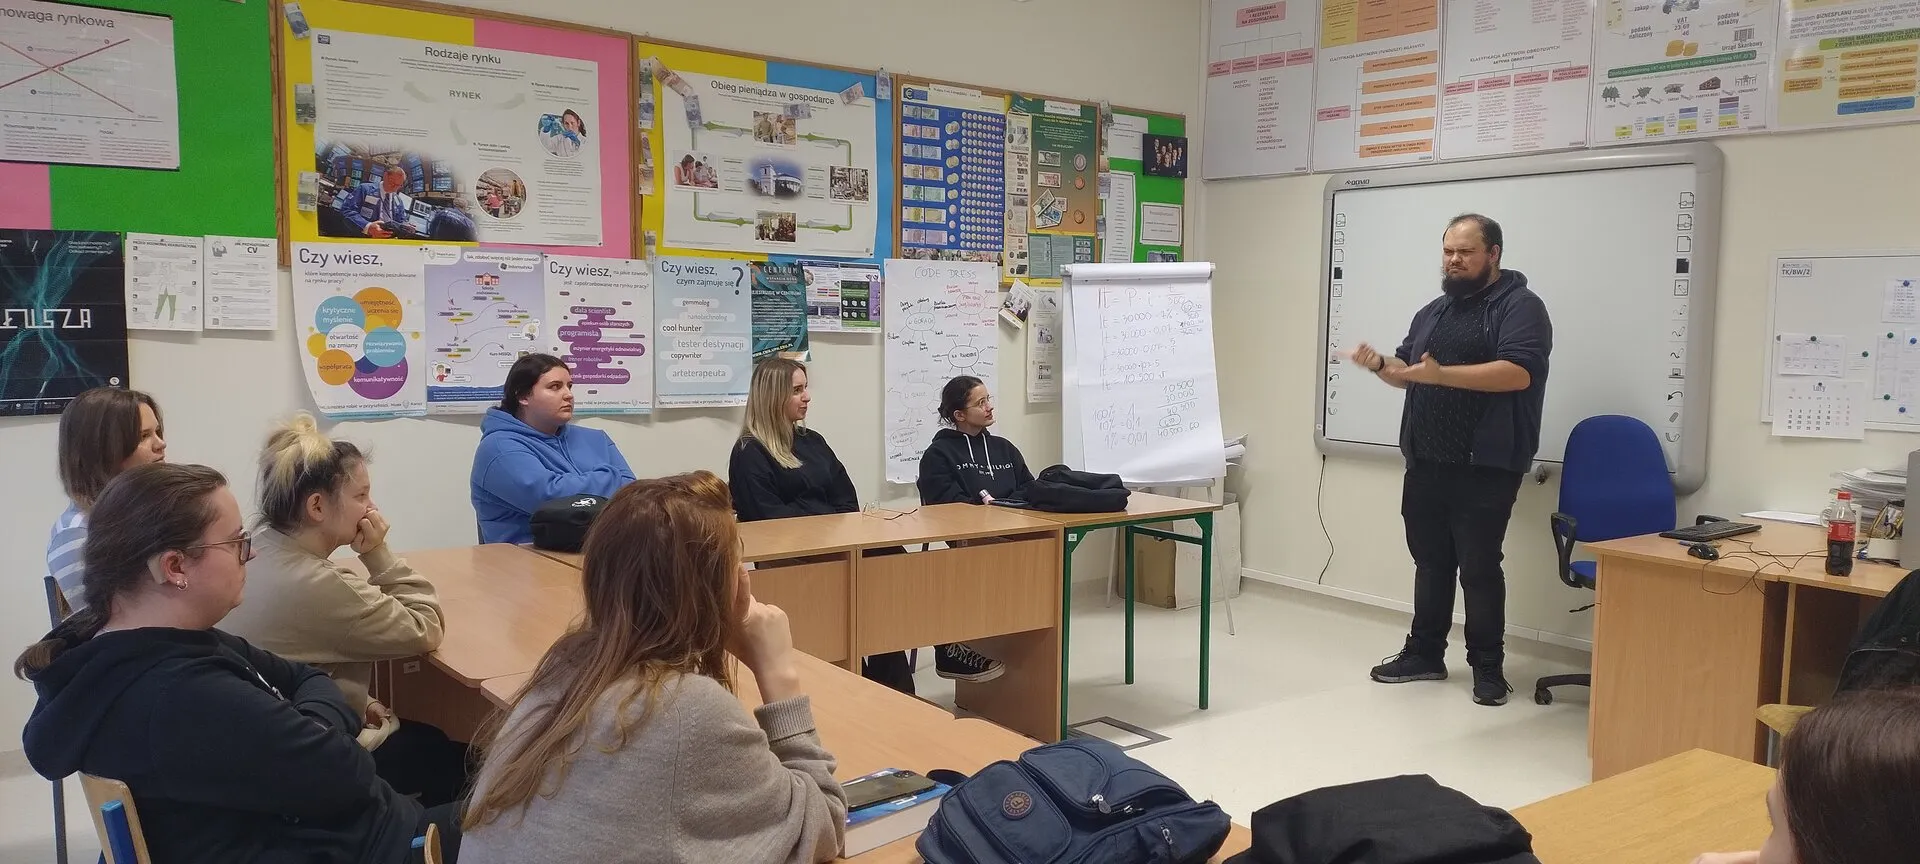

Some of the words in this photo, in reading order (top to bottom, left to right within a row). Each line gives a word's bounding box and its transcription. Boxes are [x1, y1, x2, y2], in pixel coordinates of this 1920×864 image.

[57, 13, 115, 29] rynkowa
[1677, 16, 1688, 24] VAT
[425, 45, 469, 62] Rodzaje
[471, 52, 501, 65] rynku
[449, 89, 482, 100] RYNEK
[711, 79, 737, 93] Obieg
[738, 84, 777, 99] pieniądza
[788, 92, 835, 106] gospodarce
[247, 246, 258, 254] CV
[299, 248, 329, 268] Czy
[333, 250, 383, 268] wiesz,
[550, 261, 573, 279] Czy
[575, 263, 612, 279] wiesz,
[763, 265, 798, 275] CENTRUM
[914, 266, 941, 279] CODE
[950, 265, 977, 279] DRESS
[1781, 268, 1811, 276] TK/BW/2
[319, 272, 351, 281] kompetencje
[661, 260, 683, 277] Czy
[684, 262, 718, 278] wiesz,
[732, 266, 744, 295] ?
[676, 278, 695, 286] czym
[696, 278, 722, 288] zajmuje
[722, 279, 734, 289] się
[322, 305, 356, 316] krytyczne
[322, 315, 353, 325] myślenie
[662, 323, 677, 331] cool
[678, 324, 702, 332] hunter
[329, 333, 359, 341] otwartość
[560, 329, 599, 339] programista
[337, 342, 358, 351] zmiany
[677, 339, 701, 348] tester
[702, 339, 745, 351] destynacji
[670, 351, 702, 360] copywriter
[353, 375, 404, 384] komunikatywność
[672, 369, 726, 380] arteterapeuta
[1176, 378, 1195, 390] 500
